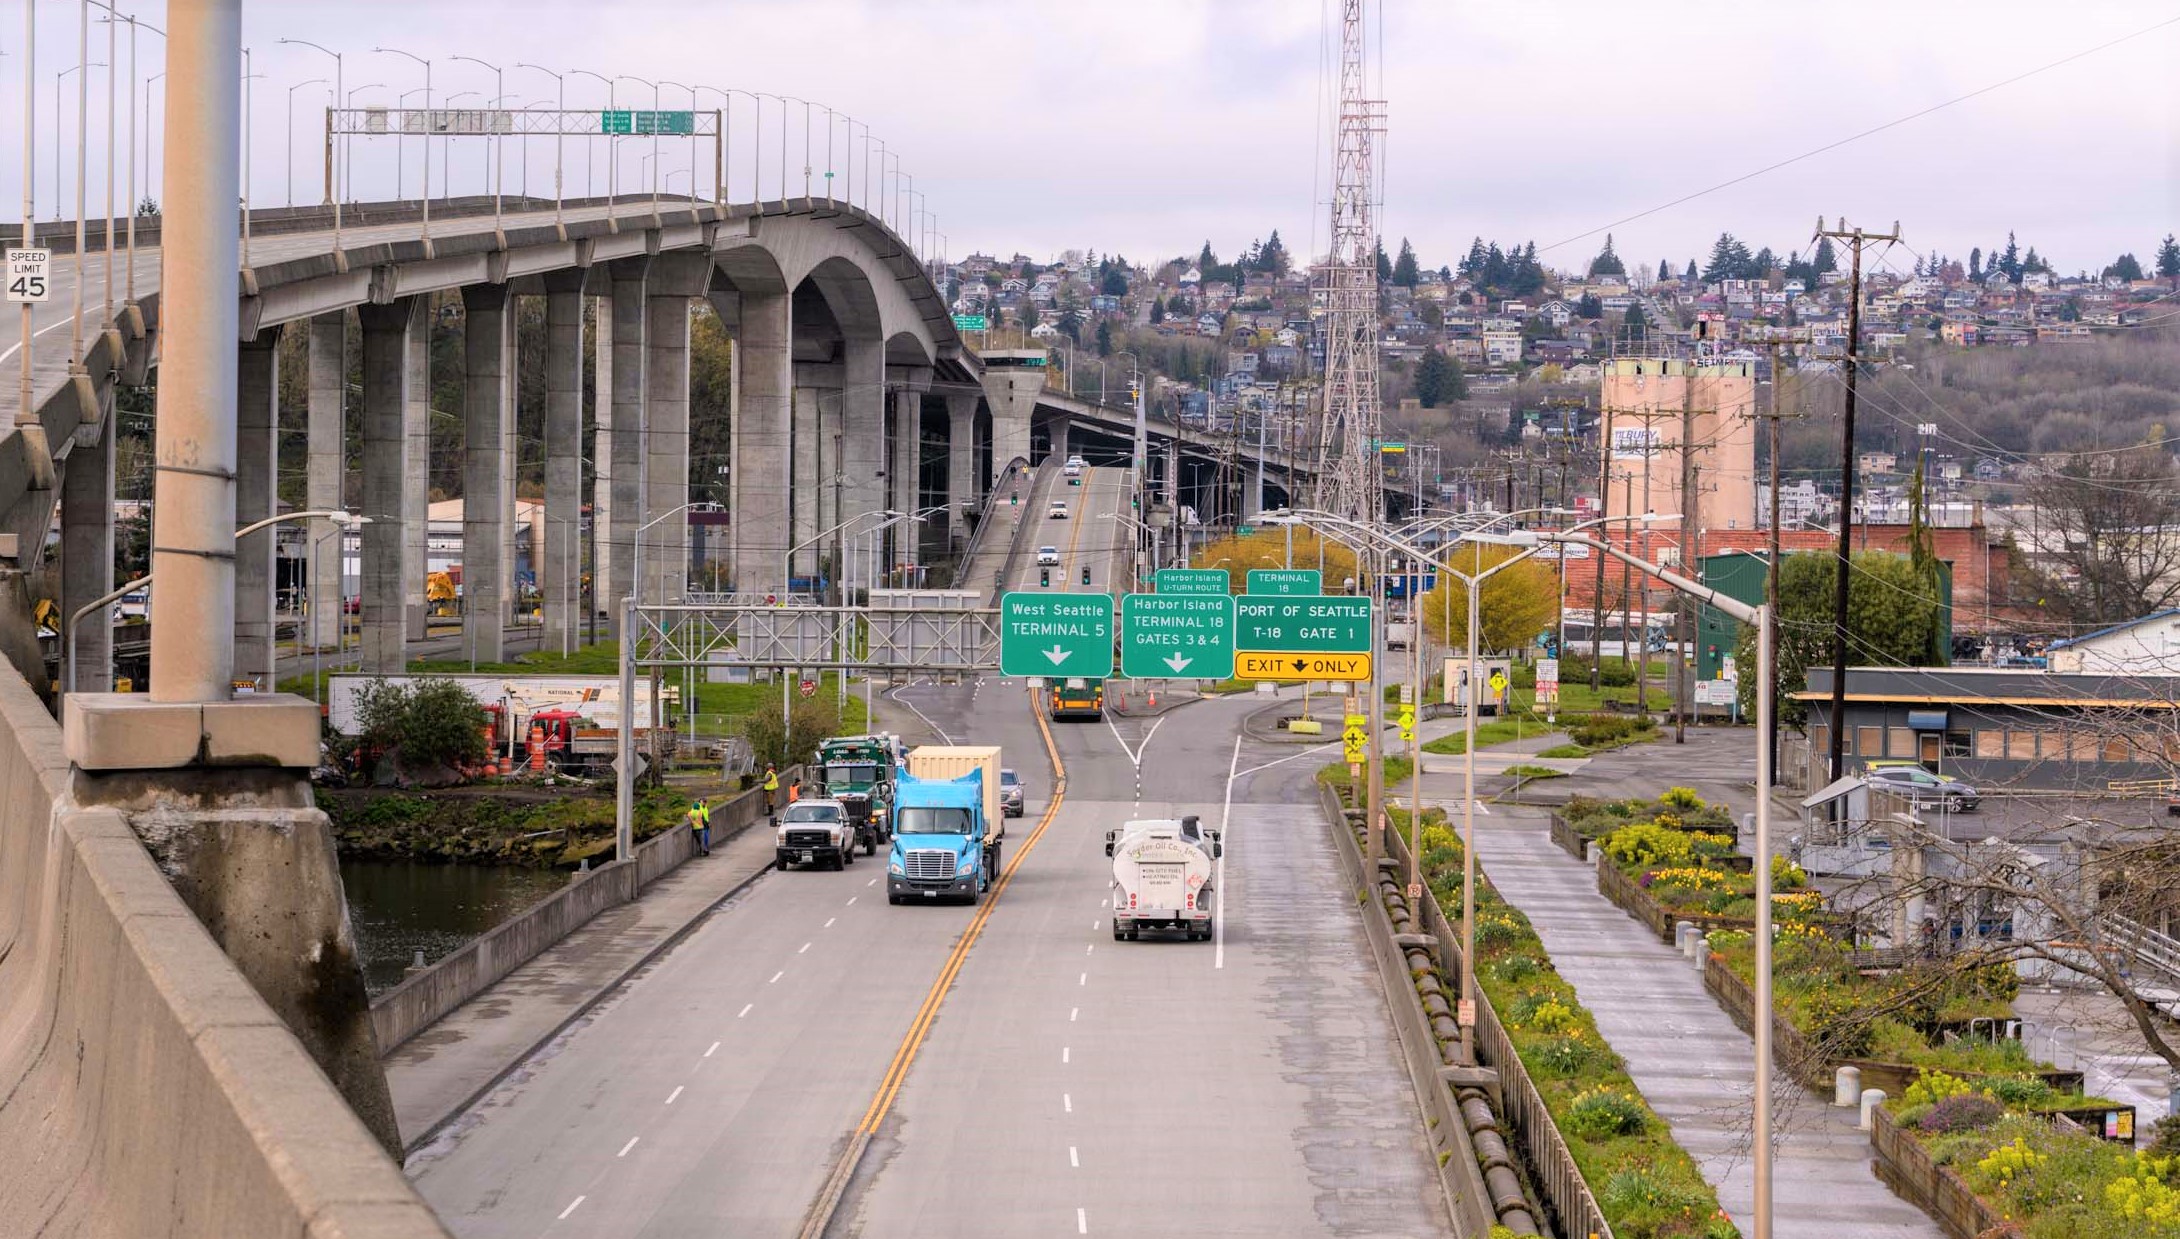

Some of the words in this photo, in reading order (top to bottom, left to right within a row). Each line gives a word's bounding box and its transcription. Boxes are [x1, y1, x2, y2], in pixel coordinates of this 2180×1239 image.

[11, 252, 46, 262] SPEED
[14, 264, 41, 274] LIMIT
[9, 276, 45, 297] 45
[1163, 574, 1193, 582] Harbor
[1195, 574, 1222, 582] Island
[1258, 573, 1310, 583] TERMINAL
[1163, 584, 1193, 592] U-TURN
[1195, 584, 1222, 592] ROUTE
[1279, 584, 1289, 593] 18
[1012, 603, 1046, 616] West
[1053, 603, 1104, 617] Seattle
[1134, 598, 1180, 610] Harbor
[1183, 599, 1223, 611] Island
[1239, 605, 1275, 617] PORT
[1282, 606, 1301, 617] OF
[1308, 606, 1368, 618] SEATTLE
[1133, 615, 1205, 628] TERMINAL
[1209, 617, 1224, 628] 18
[1011, 622, 1089, 637] TERMINAL
[1095, 624, 1105, 637] 5
[1253, 627, 1282, 639] T-18
[1299, 628, 1337, 639] GATE
[1348, 628, 1354, 639] 1
[1136, 633, 1180, 645] GATES
[1185, 634, 1194, 645] 3
[1197, 634, 1206, 646] &
[1209, 634, 1220, 646] 4
[1247, 659, 1284, 672] EXIT
[1313, 660, 1358, 673] ONLY
[1155, 842, 1166, 850] Oil
